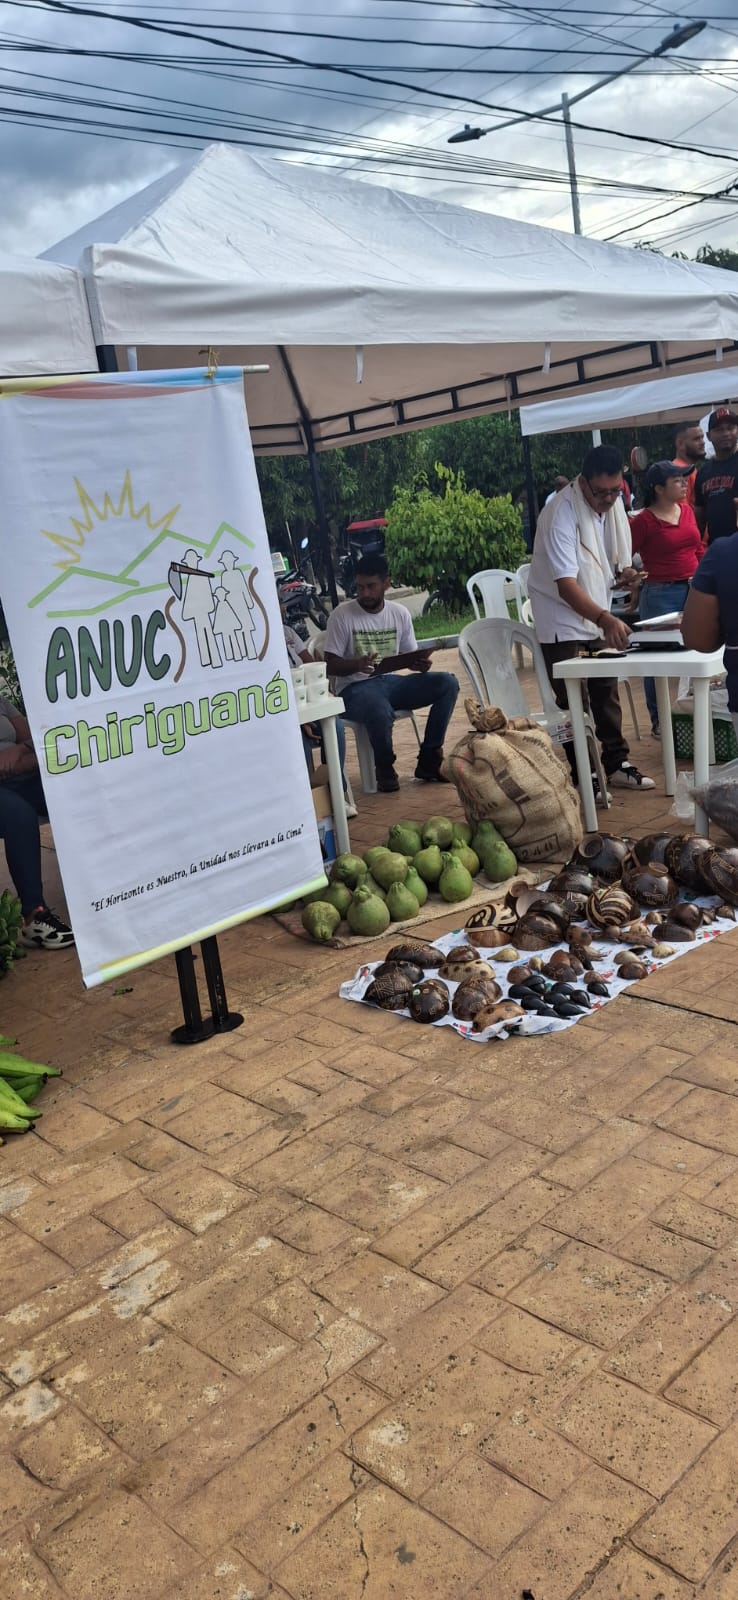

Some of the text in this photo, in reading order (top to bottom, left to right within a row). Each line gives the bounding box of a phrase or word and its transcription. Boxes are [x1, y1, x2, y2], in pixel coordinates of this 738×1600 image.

[45, 609, 171, 703] ANUC
[43, 670, 290, 775] Chiriguaná
[105, 885, 145, 908] Horizonte
[146, 881, 155, 892] es
[156, 869, 188, 888] Nuestro,
[190, 863, 198, 874] la
[199, 851, 227, 871] Unidad
[228, 849, 241, 861] nos
[242, 840, 269, 856] Llevara
[270, 836, 276, 845] a
[277, 832, 285, 843] la
